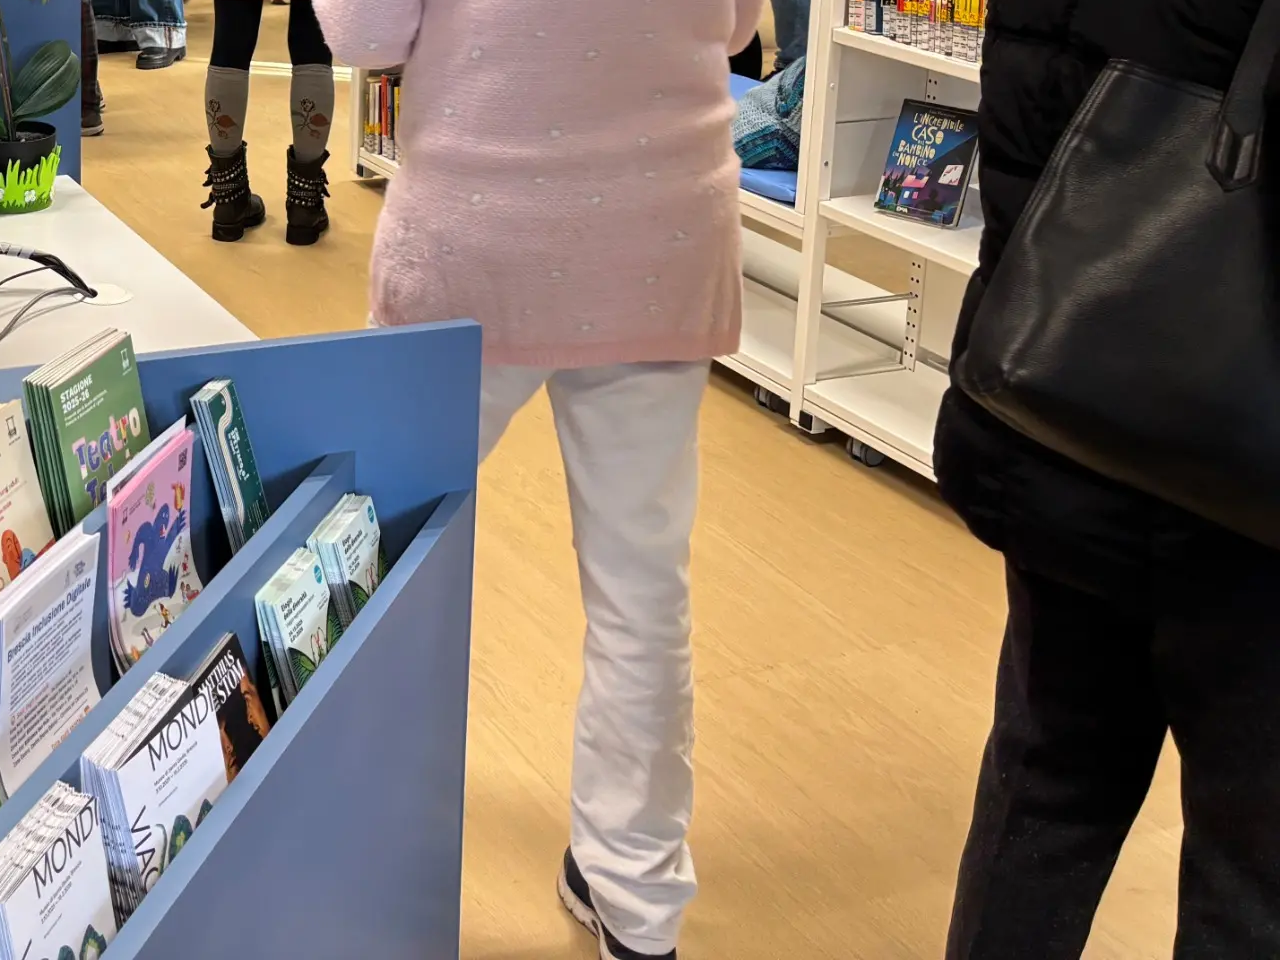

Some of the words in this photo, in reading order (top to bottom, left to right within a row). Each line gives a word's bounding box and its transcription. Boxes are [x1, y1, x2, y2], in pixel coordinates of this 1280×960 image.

[912, 125, 944, 145] CASO
[913, 112, 964, 132] L'INCREDIBILE
[897, 153, 918, 168] NON
[898, 140, 936, 159] BAMBINO
[60, 373, 93, 403] STAGIONE
[62, 388, 90, 415] 2025-26
[72, 407, 141, 480] Teatro
[281, 597, 293, 612] Elogio
[7, 632, 32, 663] Brescia
[32, 600, 66, 638] Inclusione
[66, 577, 91, 606] Digitale
[216, 658, 245, 705] STOM
[147, 686, 214, 771] MONDI
[33, 796, 100, 899] MONDI
